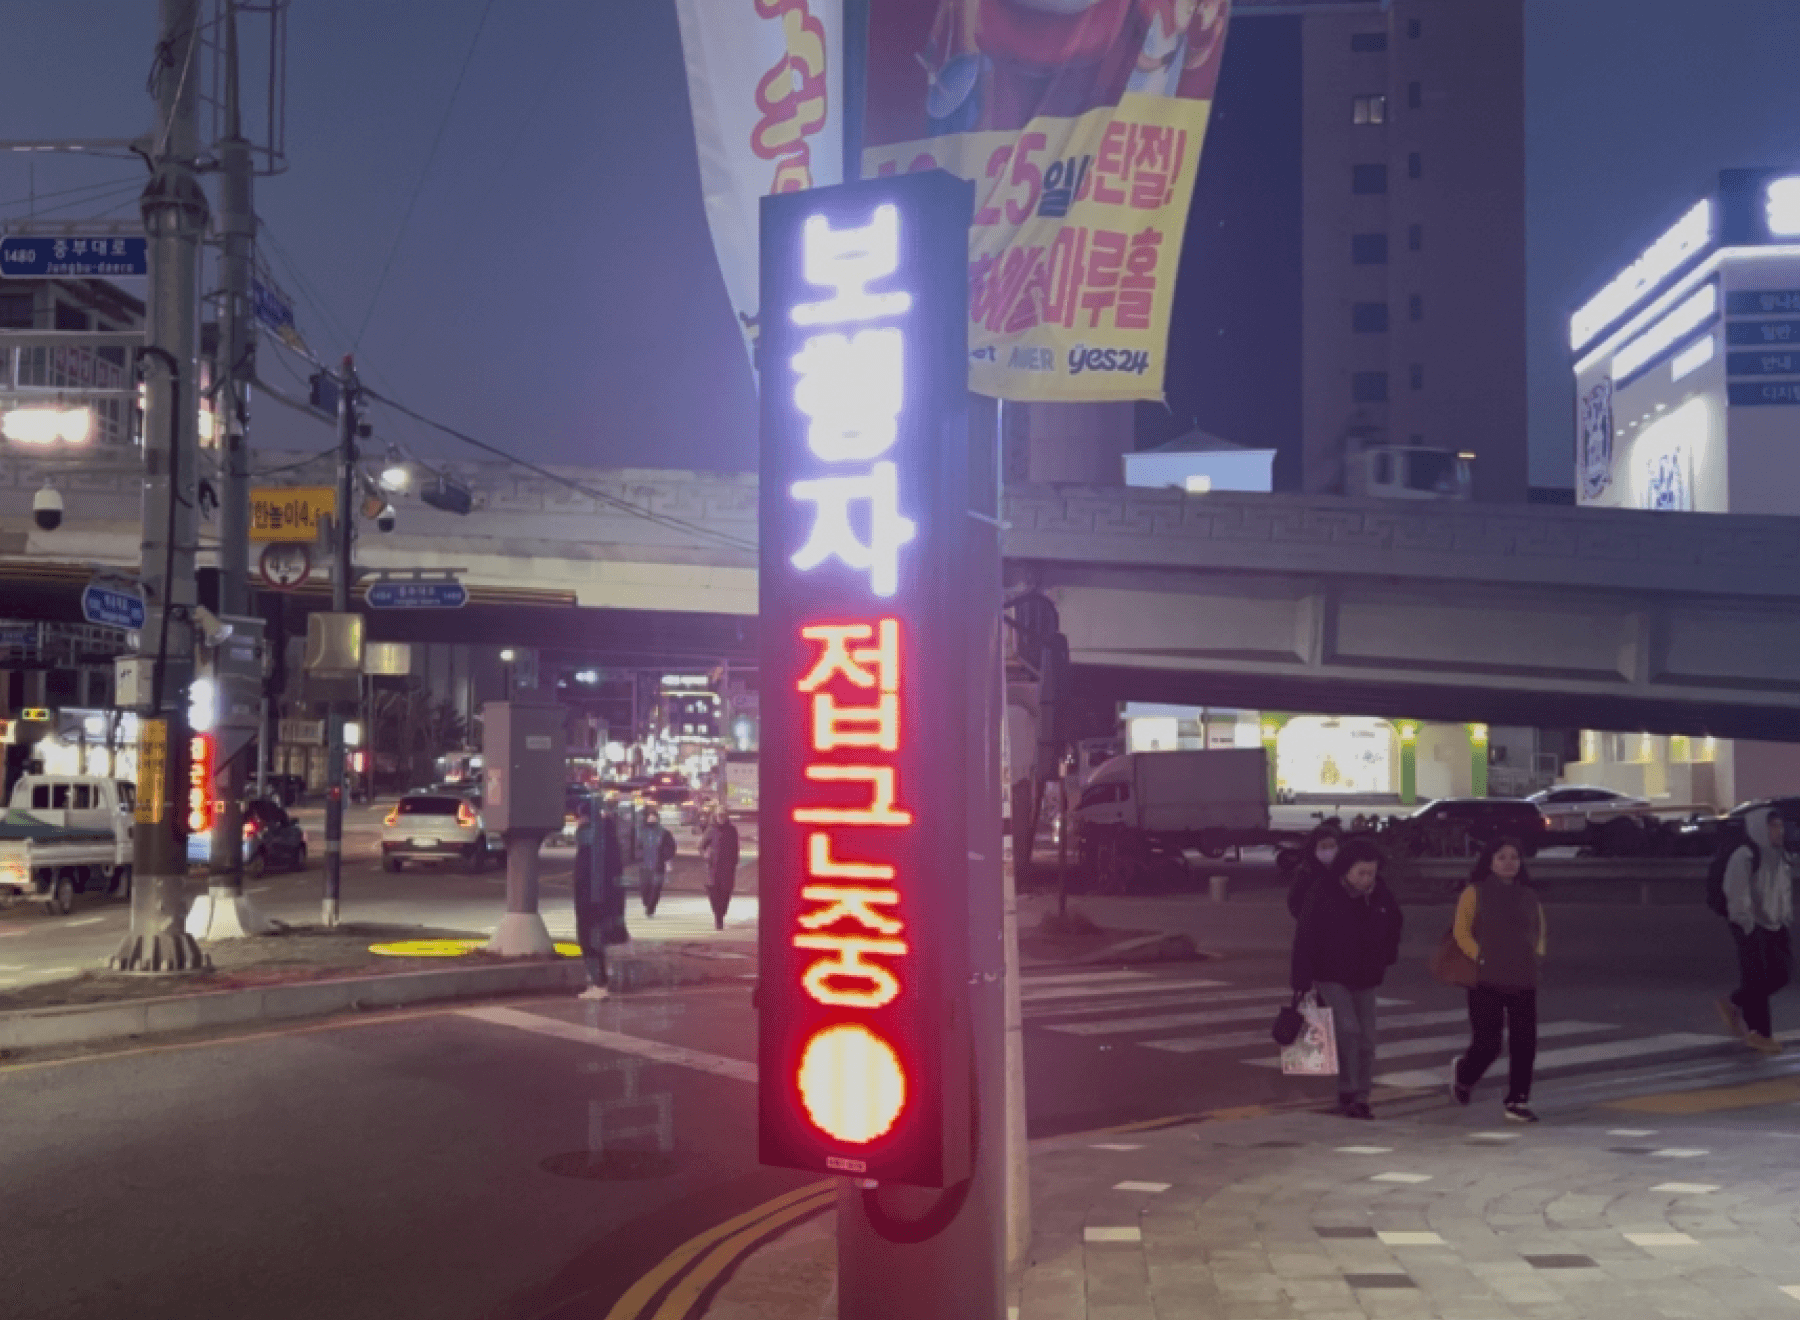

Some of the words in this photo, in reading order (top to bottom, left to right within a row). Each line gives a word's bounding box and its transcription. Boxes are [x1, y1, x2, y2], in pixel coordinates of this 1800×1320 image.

[52, 239, 127, 260] 중부대로
[1068, 343, 1150, 376] yes24
[792, 617, 914, 1009] 접근중
